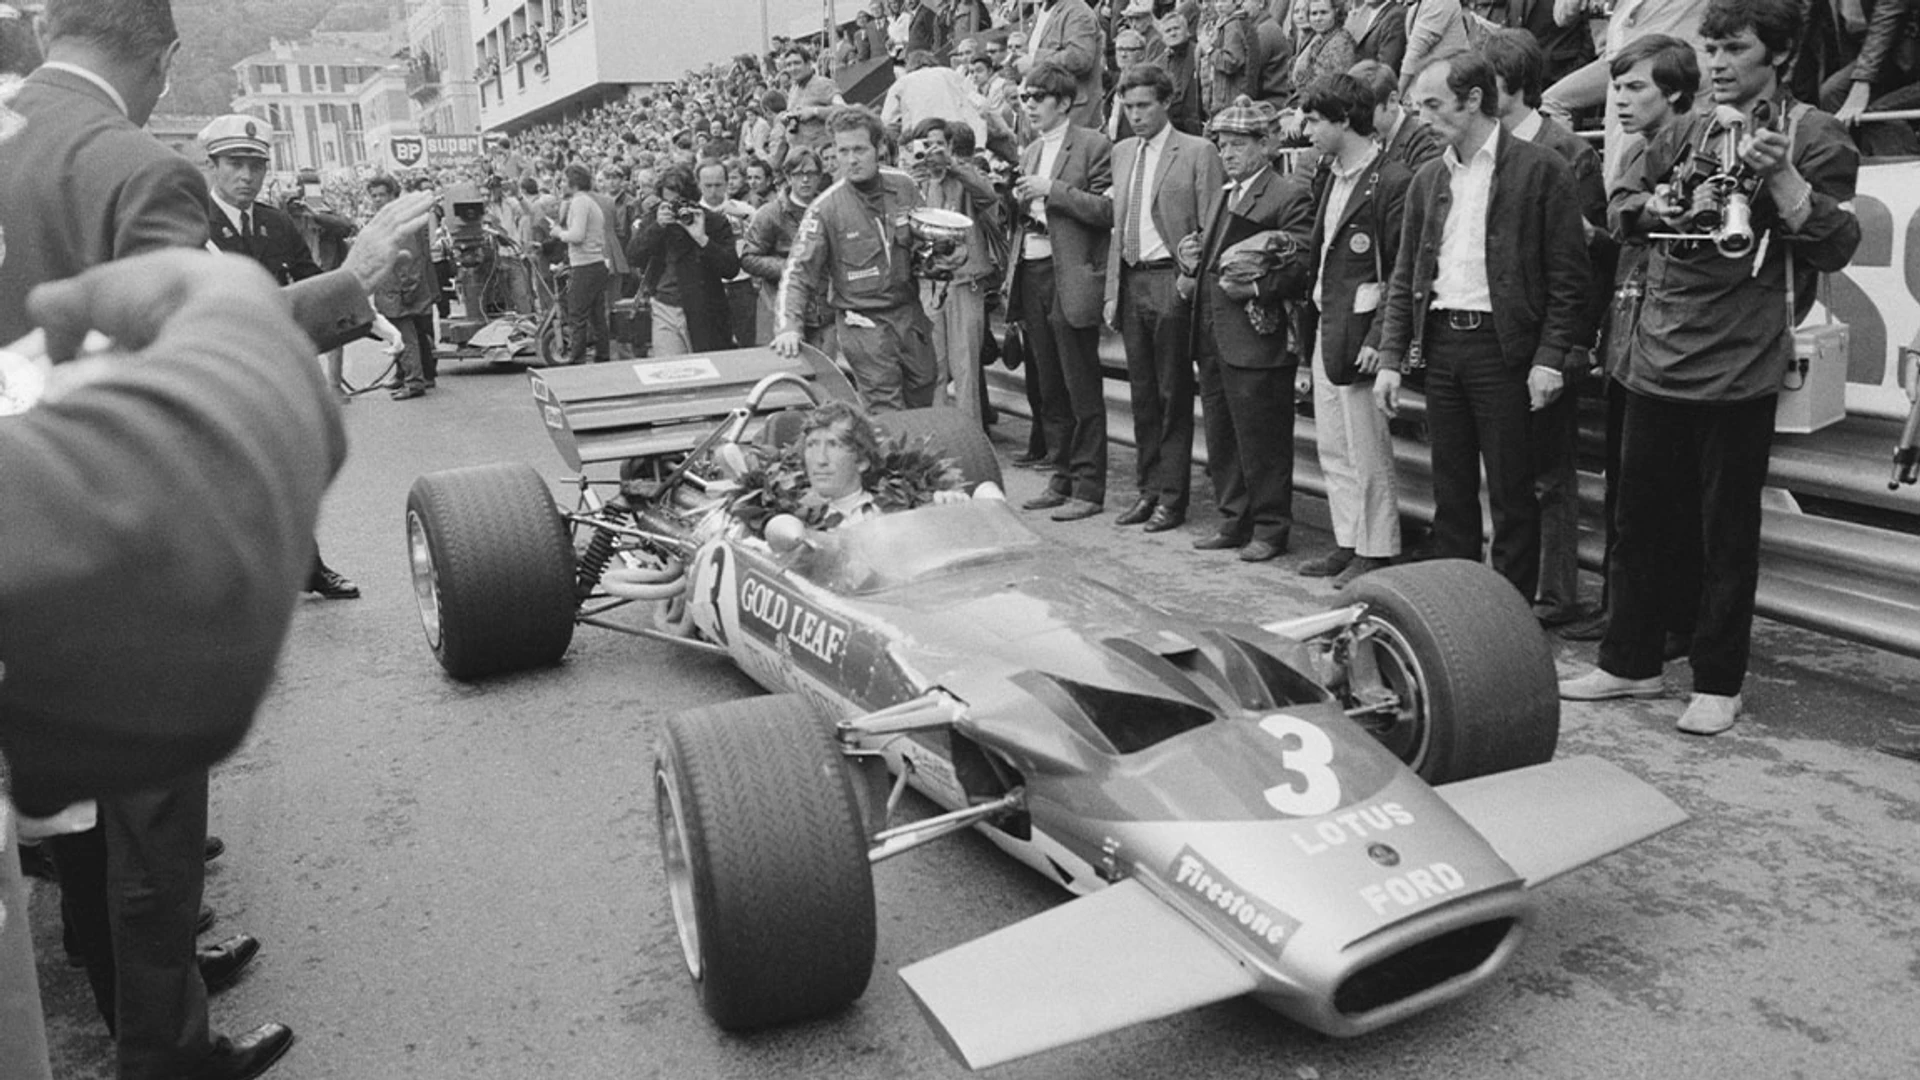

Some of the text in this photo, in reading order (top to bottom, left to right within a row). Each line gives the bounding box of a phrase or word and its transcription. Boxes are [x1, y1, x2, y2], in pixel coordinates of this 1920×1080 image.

[396, 142, 421, 160] BP
[427, 138, 479, 155] super
[709, 545, 729, 647] 3
[741, 578, 845, 663] GOLD LEAF
[1258, 713, 1342, 817] 3
[1291, 802, 1415, 856] LOTUS
[1174, 854, 1287, 945] Firestone
[1358, 861, 1466, 916] FORD
